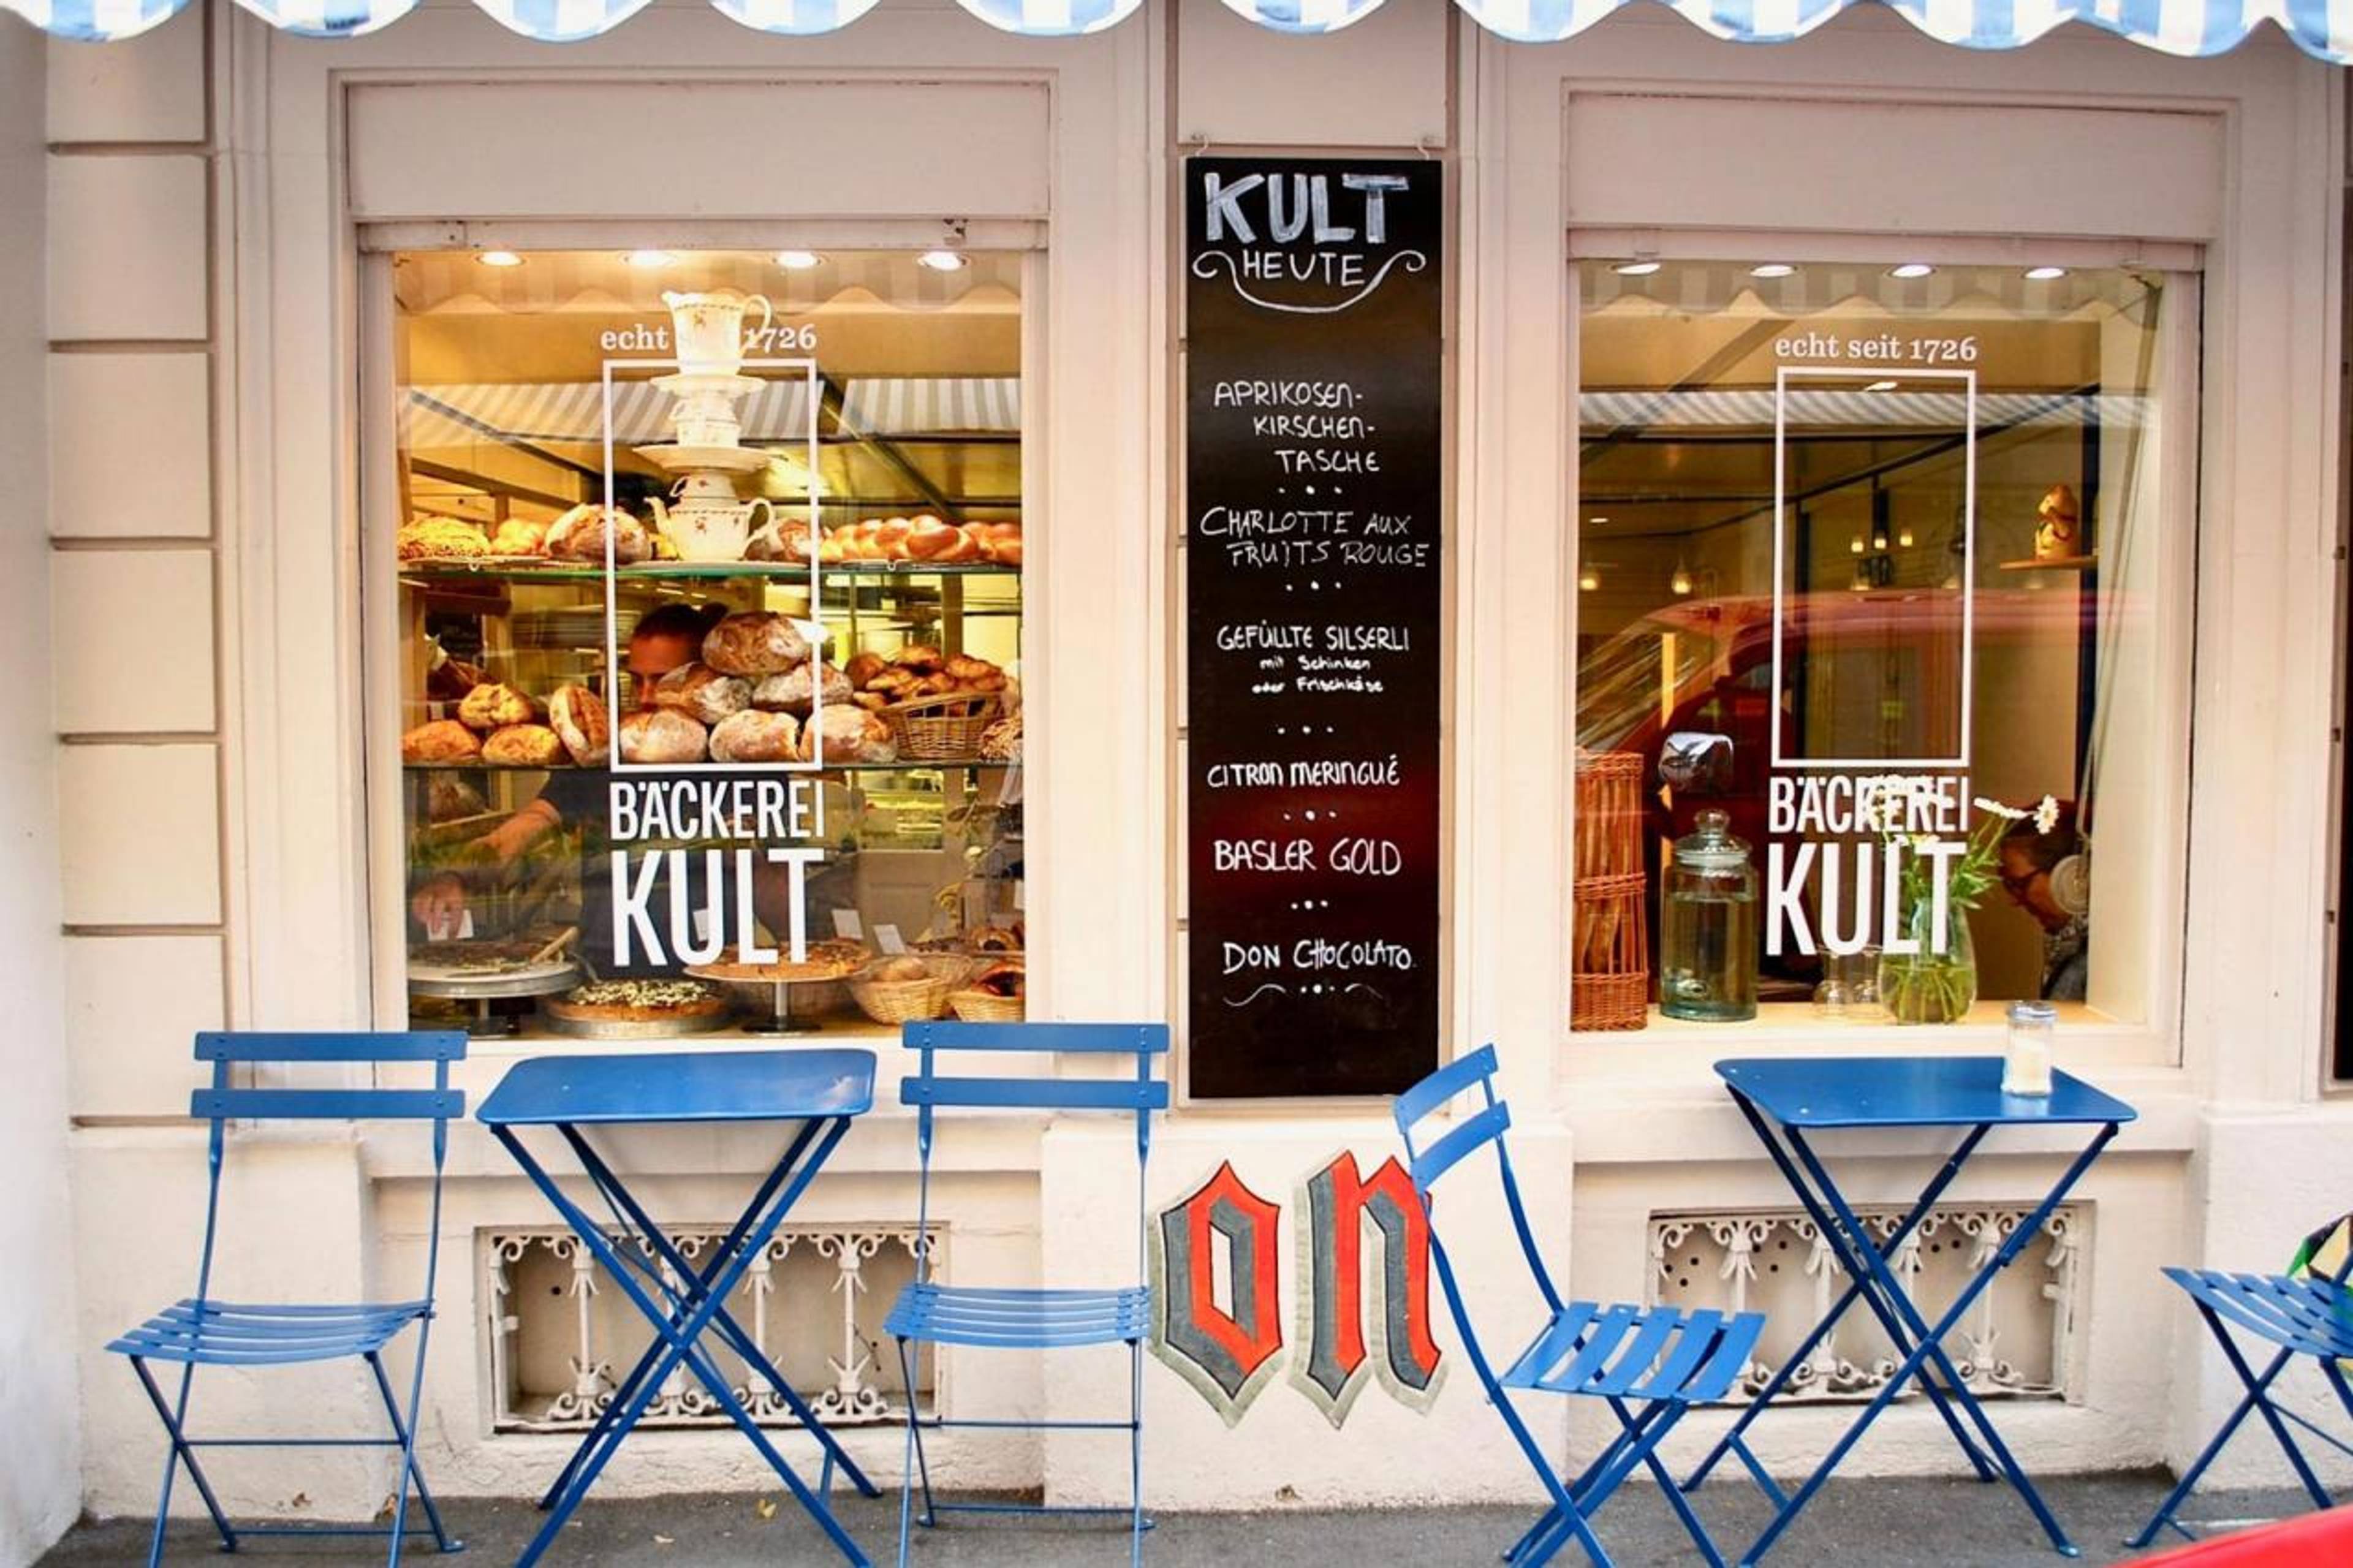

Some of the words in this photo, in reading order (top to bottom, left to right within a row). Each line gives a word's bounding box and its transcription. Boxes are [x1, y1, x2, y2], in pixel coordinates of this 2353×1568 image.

[1204, 172, 1409, 244] KULT
[1243, 249, 1365, 287] HEUTE
[601, 324, 669, 350] echt
[743, 323, 817, 354] 1726
[1775, 333, 1839, 358] echt
[1847, 333, 1900, 359] seit
[1909, 336, 1977, 364] 1726
[1214, 381, 1363, 409] APRIKOSEN-
[1253, 415, 1375, 439] KIRSCHEN-
[1274, 449, 1381, 474] TASCHE
[1200, 506, 1354, 539] CHARLOTTE
[1363, 513, 1411, 536] AUX
[1226, 540, 1332, 567] FRUITS
[1339, 543, 1430, 567] ROUGE
[1217, 619, 1313, 651] GEFÜLLTE
[1325, 625, 1410, 651] SILSERLI
[1297, 654, 1371, 670] Schinken
[1207, 763, 1284, 787] CITRON
[1290, 754, 1401, 787] MERINGUÉ
[610, 779, 824, 841] BÄCKEREI
[1768, 775, 1969, 833] BÄCKEREI
[1214, 839, 1317, 871] BASLER
[1329, 838, 1402, 876] GOLD
[612, 849, 824, 967] KULT
[1766, 842, 1967, 956] KULT
[1222, 942, 1281, 974] DON
